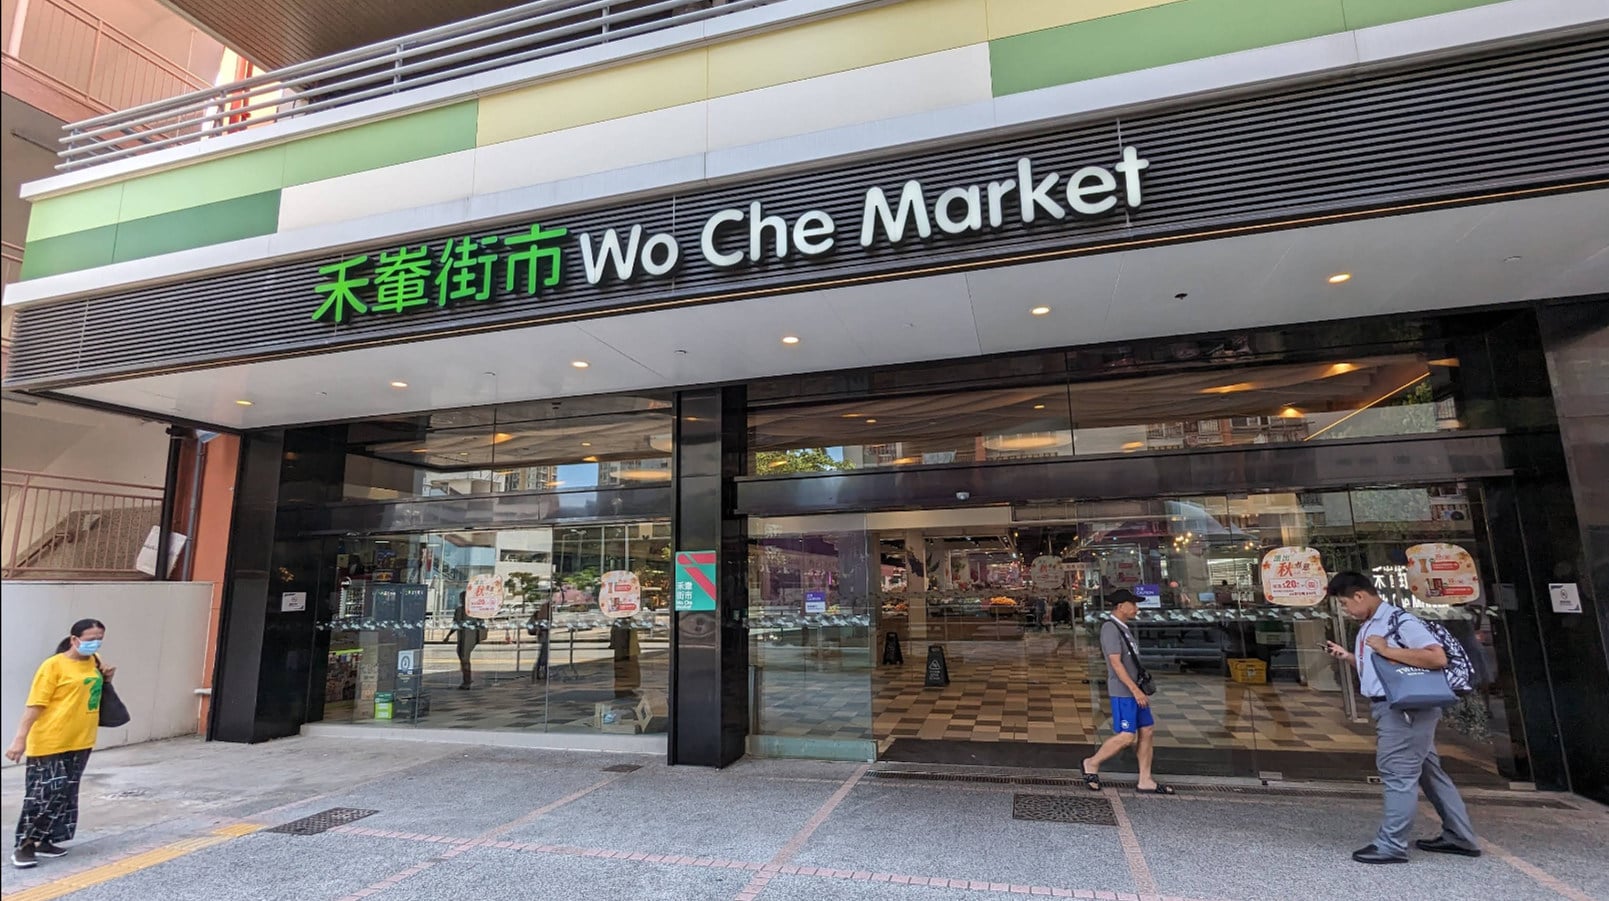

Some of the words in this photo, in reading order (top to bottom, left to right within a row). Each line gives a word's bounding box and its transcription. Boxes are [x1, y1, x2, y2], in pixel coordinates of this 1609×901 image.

[311, 223, 568, 322] 禾輋街市
[579, 223, 679, 285] Wo
[701, 201, 836, 267] Che
[860, 145, 1149, 248] Market
[1278, 562, 1292, 577] 秋
